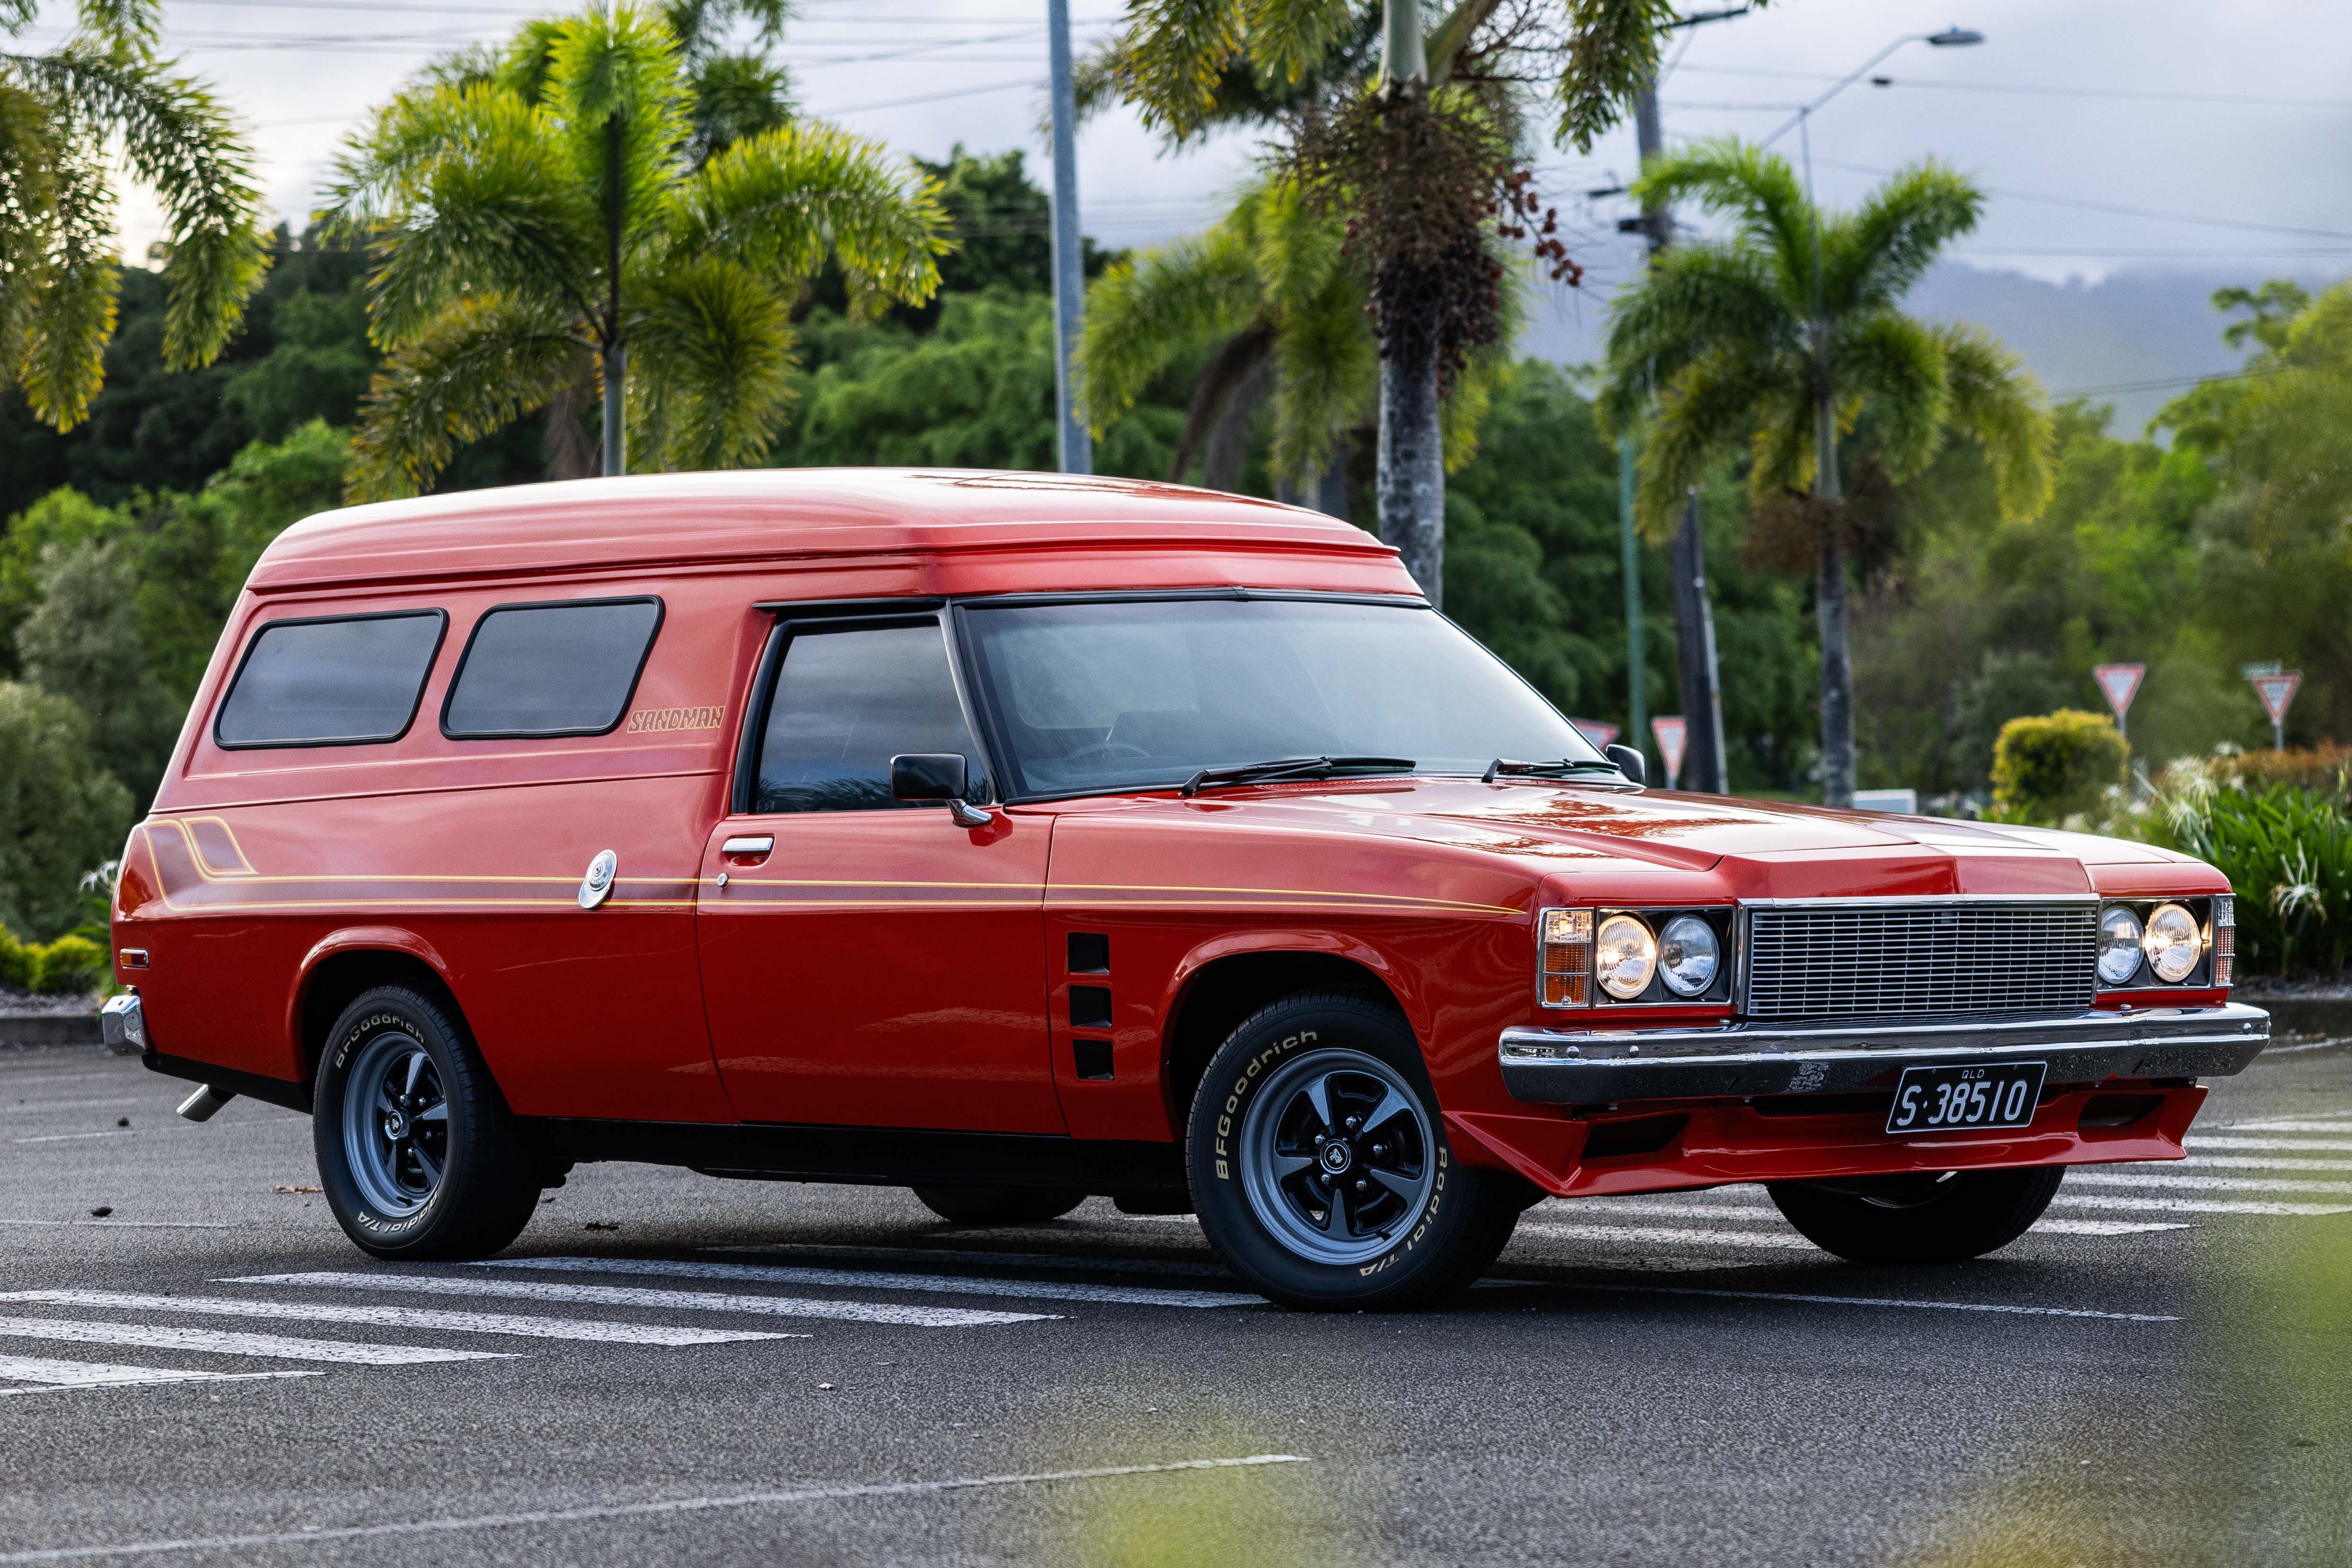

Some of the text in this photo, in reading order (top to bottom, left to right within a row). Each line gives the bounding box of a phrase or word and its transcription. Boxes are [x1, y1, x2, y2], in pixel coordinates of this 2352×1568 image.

[627, 706, 726, 733] SANDMAN
[1962, 1070, 1984, 1079] QLD
[1216, 1031, 1317, 1179] BFGoodrich
[358, 1190, 437, 1232] Radial T/A
[1359, 1147, 1447, 1277] Radial T/A
